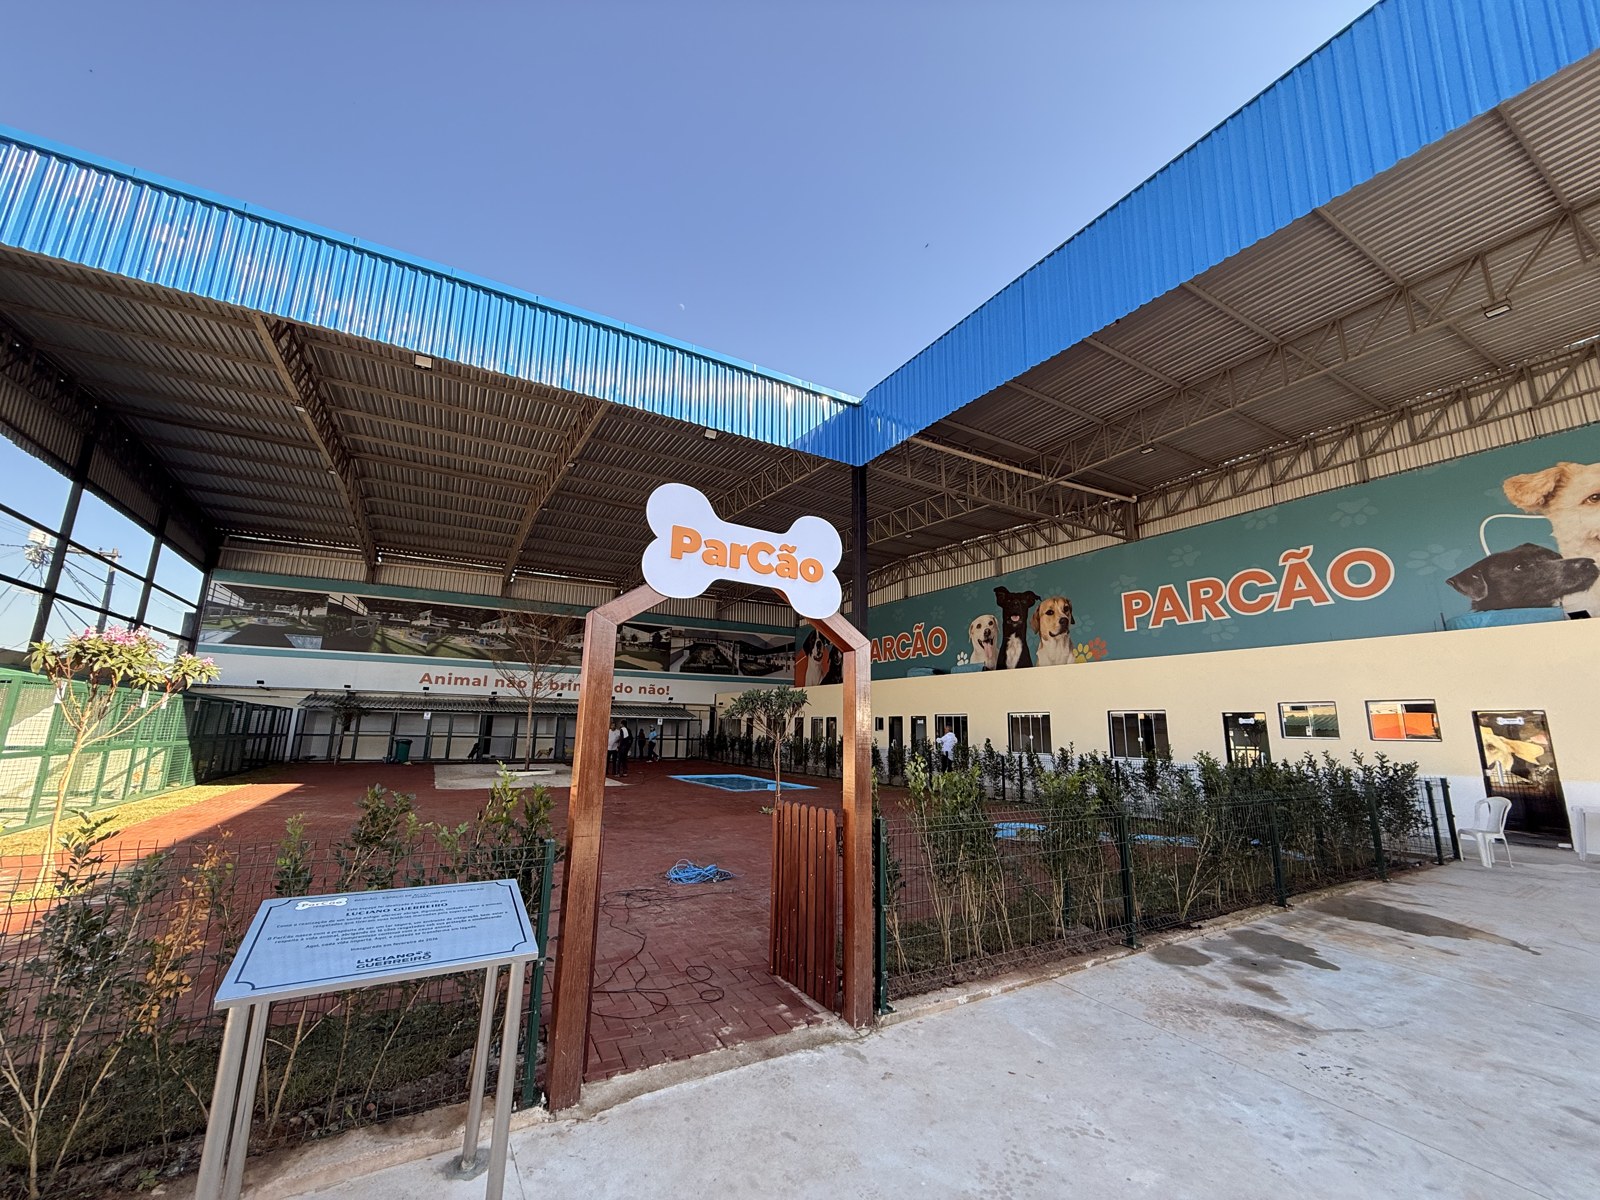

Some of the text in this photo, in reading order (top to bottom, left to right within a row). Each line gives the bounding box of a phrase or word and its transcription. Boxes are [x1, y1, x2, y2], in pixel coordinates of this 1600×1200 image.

[670, 525, 824, 583] ParCão
[1121, 545, 1395, 632] PARCÃO
[870, 622, 948, 664] ARCÃO
[418, 672, 488, 687] Animal
[638, 683, 670, 696] não!
[393, 903, 448, 911] GUERREIRO
[355, 955, 431, 969] GUERREIRO
[356, 952, 415, 964] LUCIANO
